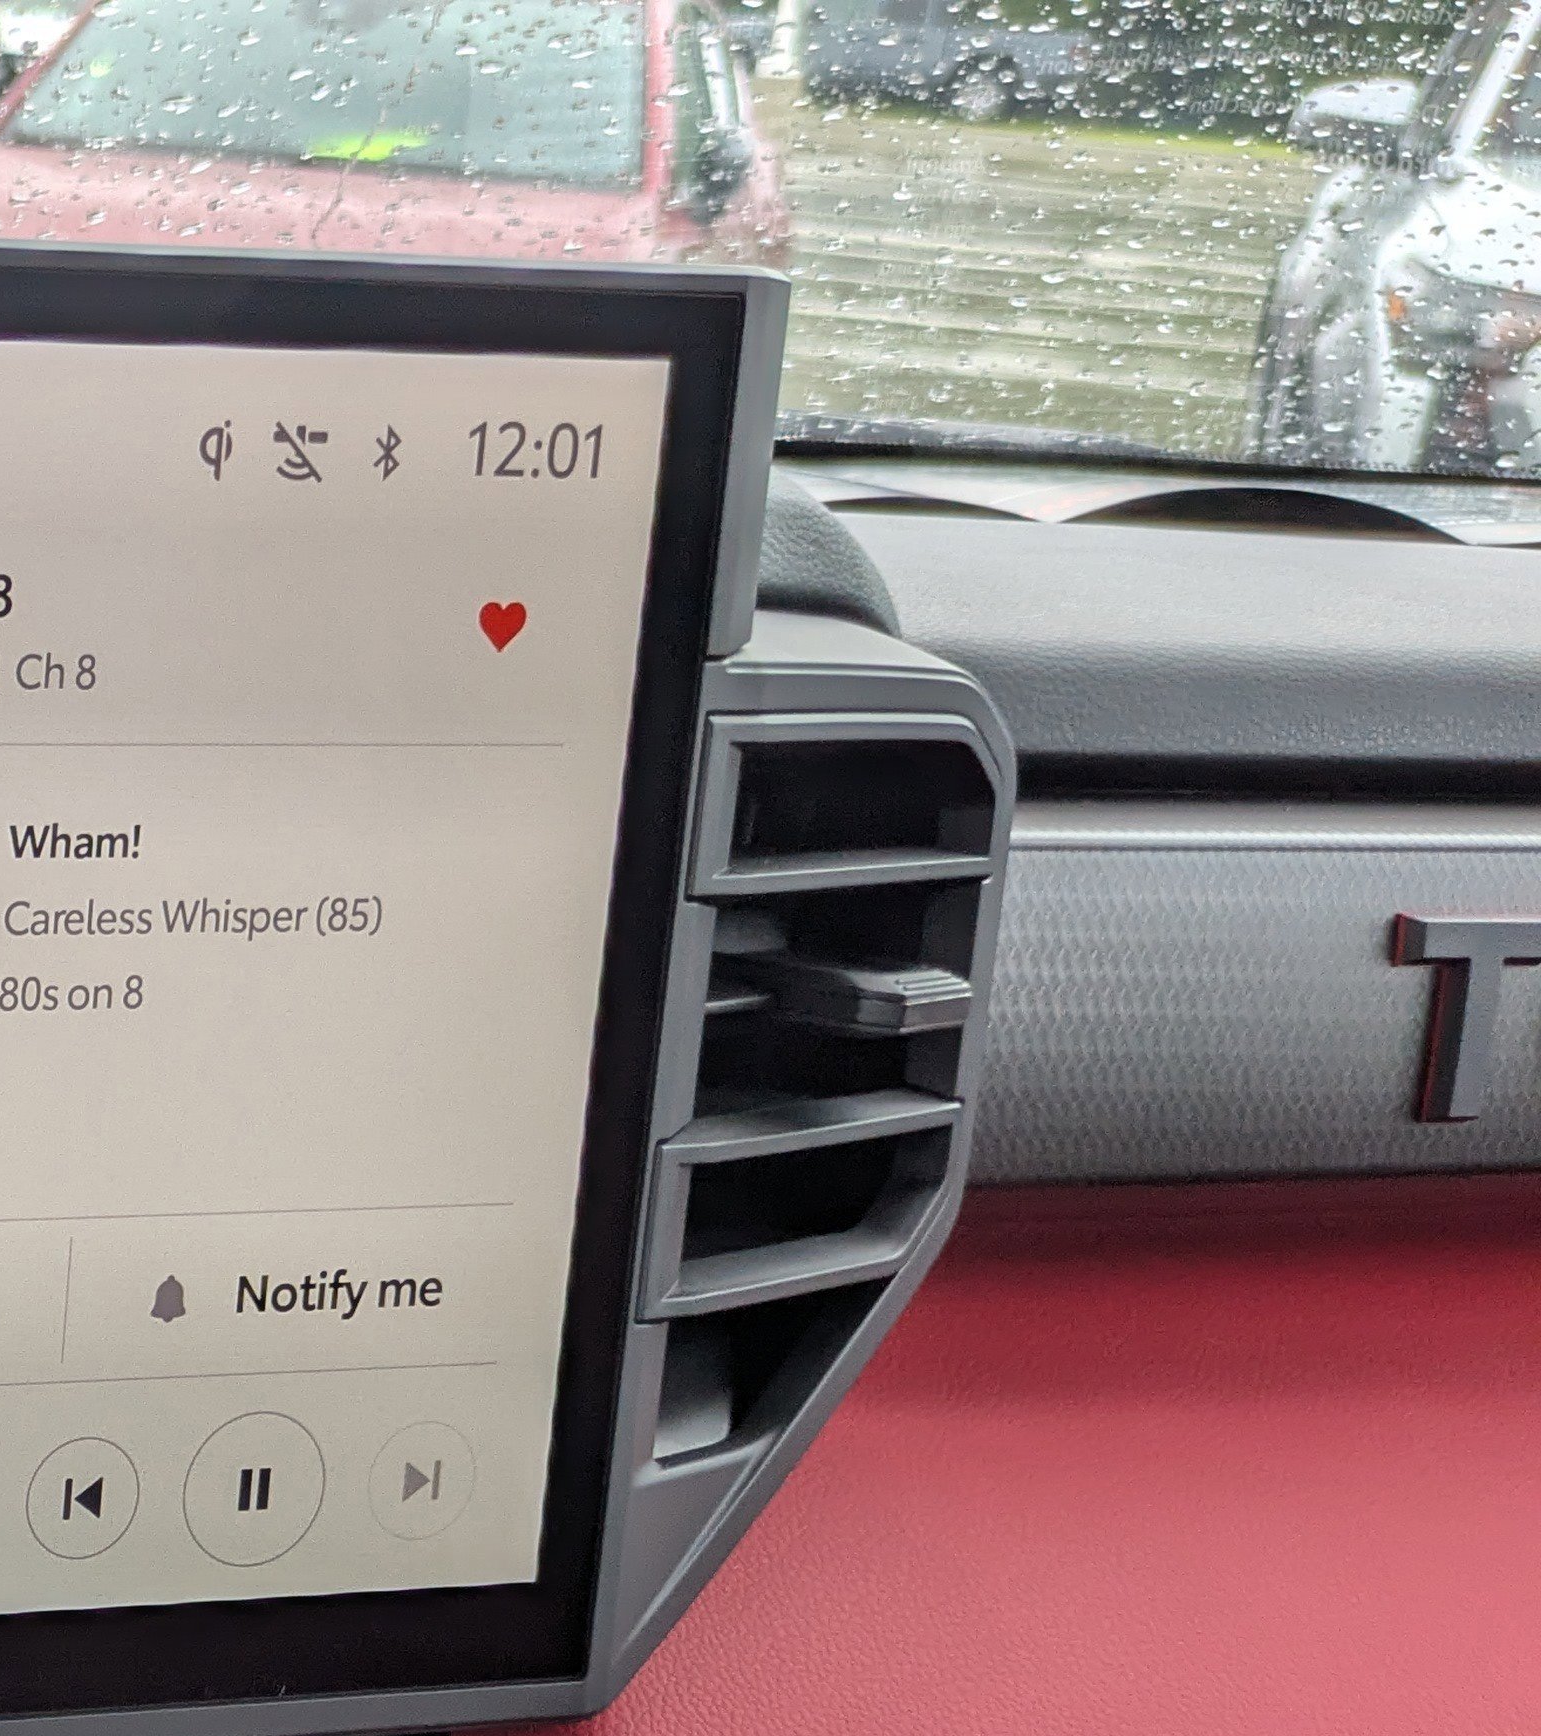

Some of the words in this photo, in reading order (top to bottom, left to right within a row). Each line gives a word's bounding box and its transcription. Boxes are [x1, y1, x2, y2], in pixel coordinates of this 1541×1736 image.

[470, 422, 602, 479] 12:01
[16, 652, 64, 690] Ch
[76, 654, 96, 690] 8
[10, 823, 141, 859] Wham!
[4, 900, 152, 936] Careless
[162, 898, 308, 941] Whisper
[316, 896, 382, 936] (85)
[68, 984, 112, 1010] on
[123, 975, 143, 1009] 8
[237, 1269, 368, 1320] Notify
[378, 1278, 442, 1307] me
